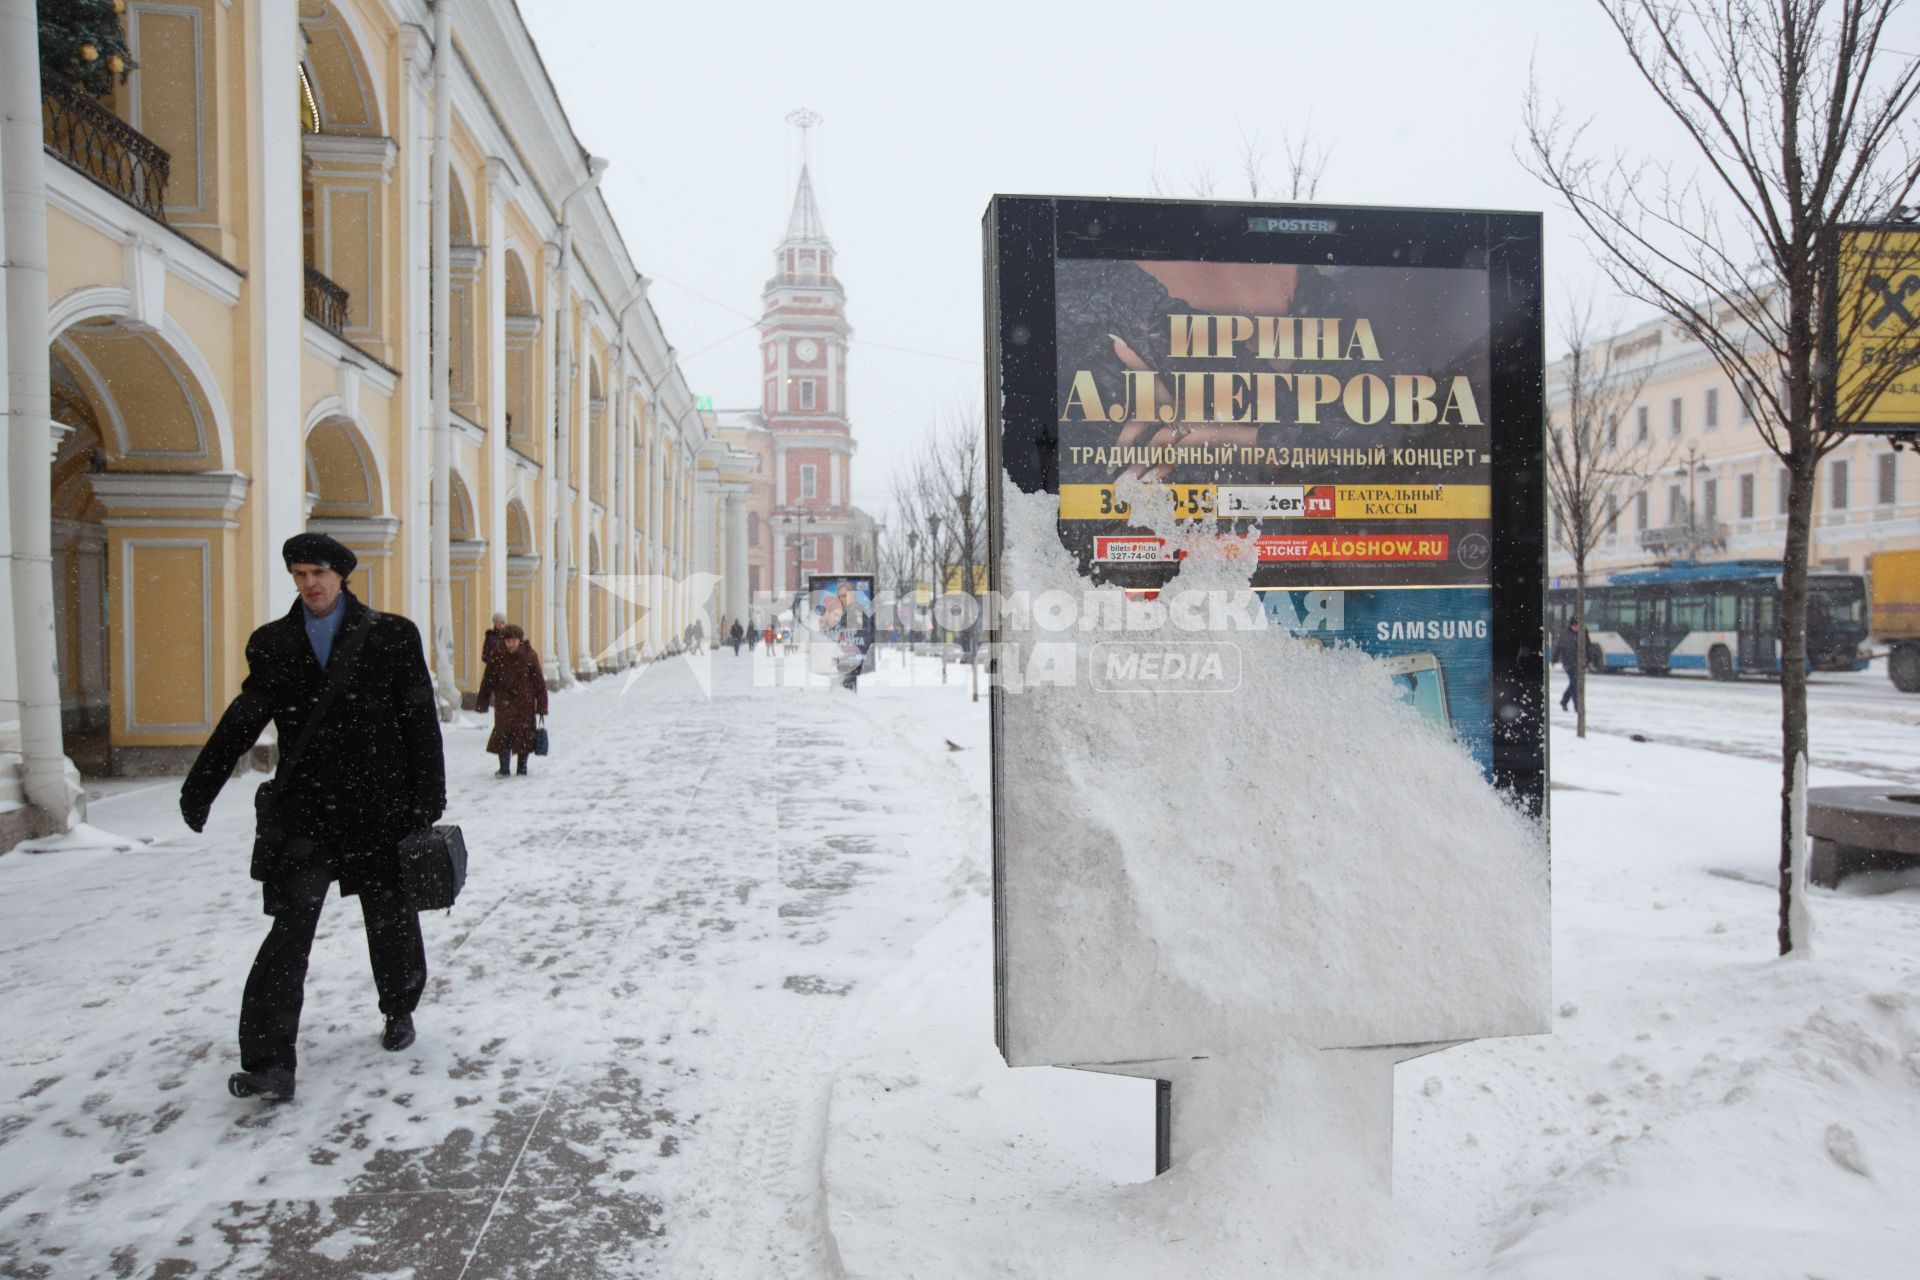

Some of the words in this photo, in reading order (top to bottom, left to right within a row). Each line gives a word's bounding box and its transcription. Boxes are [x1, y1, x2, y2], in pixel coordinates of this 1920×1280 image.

[1267, 219, 1328, 232] POSTER
[1167, 314, 1383, 361] ИРИНА
[1060, 370, 1485, 426] АЛЛЕГРОВА
[1069, 443, 1233, 468] ТРАДИЦИОННЫЙ
[1240, 444, 1386, 468] ПРАЗДНИЧНЫЙ
[1393, 448, 1476, 469] КОНЦЕРТ
[1338, 488, 1444, 502] ТЕАТРАЛЬНЫЕ
[1365, 503, 1418, 515] КАССЫ
[1110, 552, 1157, 560] 327-74-00
[1309, 540, 1442, 556] ALLOSHOW.RU
[1460, 544, 1488, 560] 12+
[1376, 620, 1487, 641] SAMSUNG
